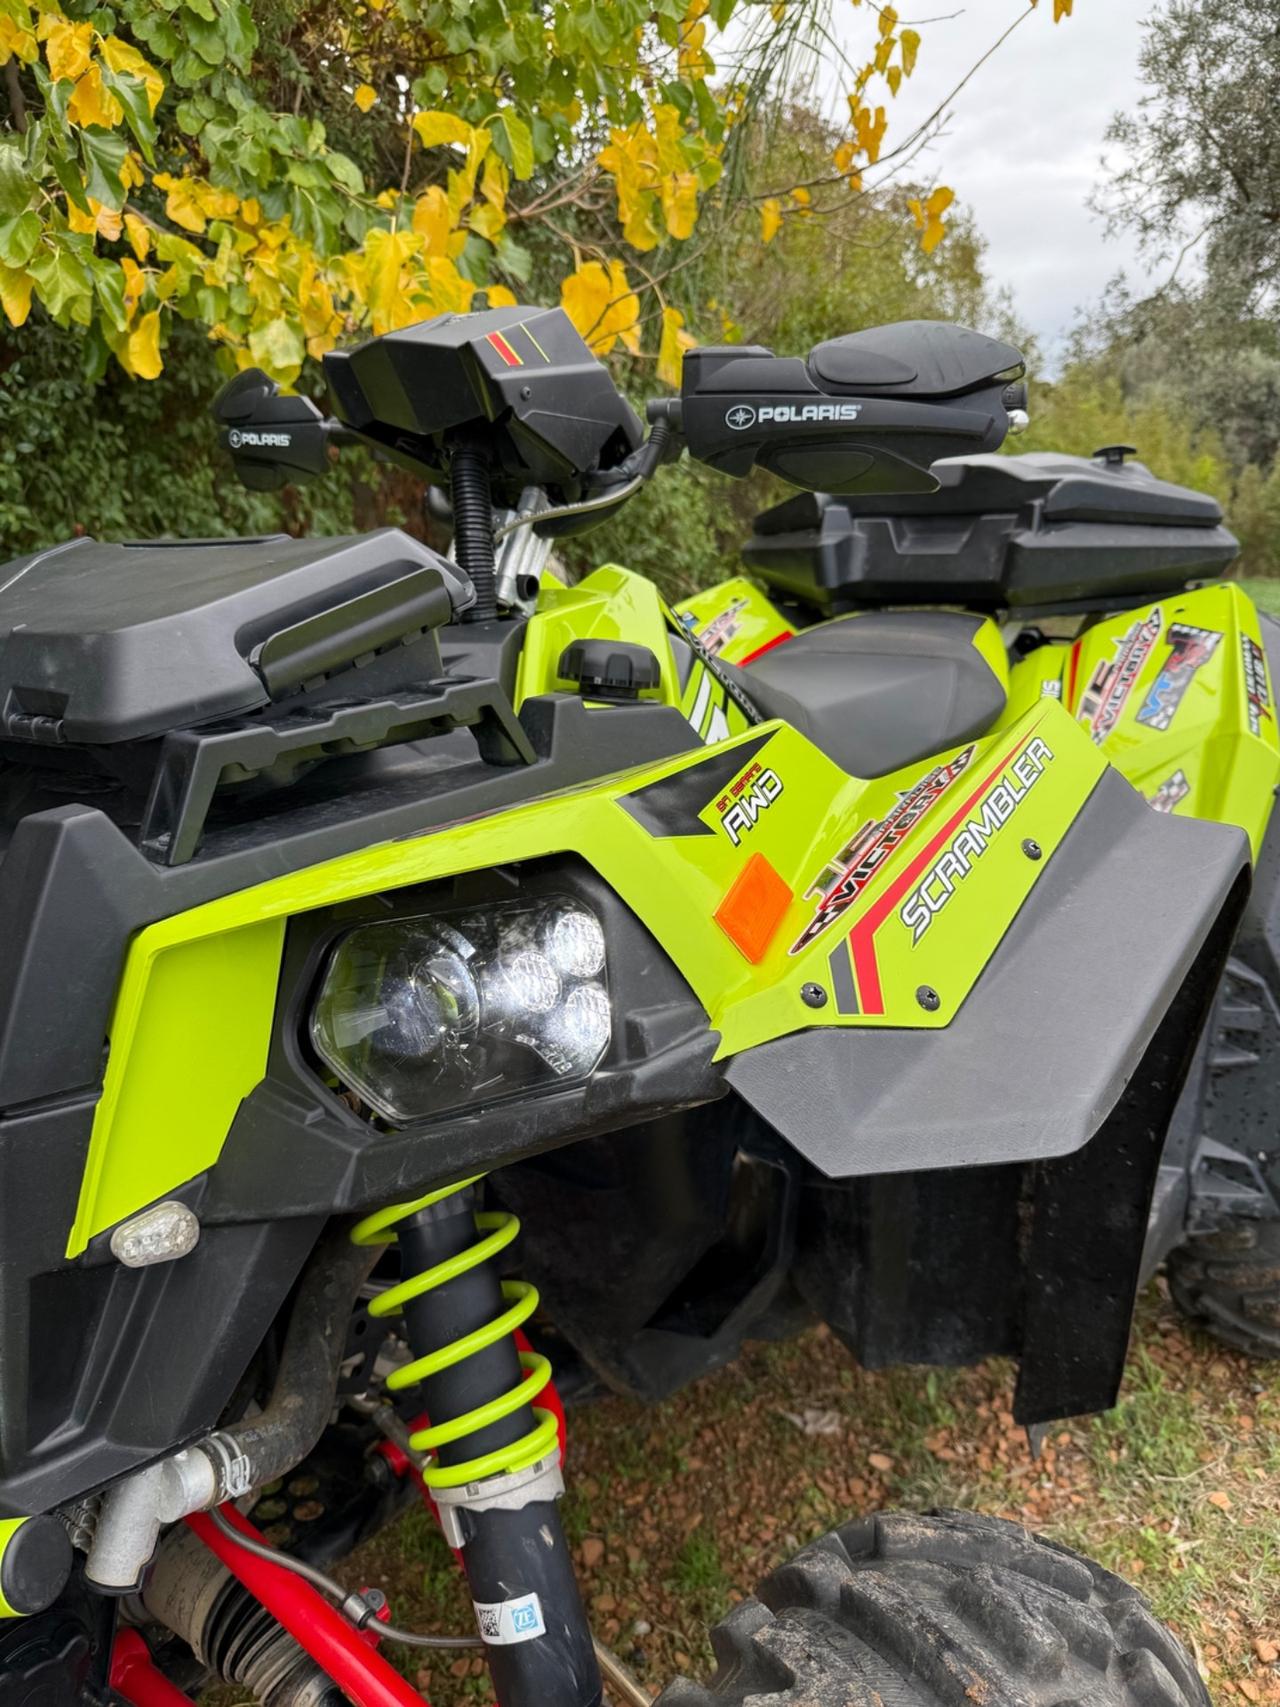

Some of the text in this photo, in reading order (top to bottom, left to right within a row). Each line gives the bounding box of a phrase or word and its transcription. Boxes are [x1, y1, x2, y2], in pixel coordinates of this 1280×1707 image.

[241, 432, 292, 447] POLARIS
[758, 404, 859, 423] POLARIS
[720, 768, 784, 848] AWD
[829, 768, 951, 904] VICTORY
[899, 736, 1054, 949] SCRAMBLER
